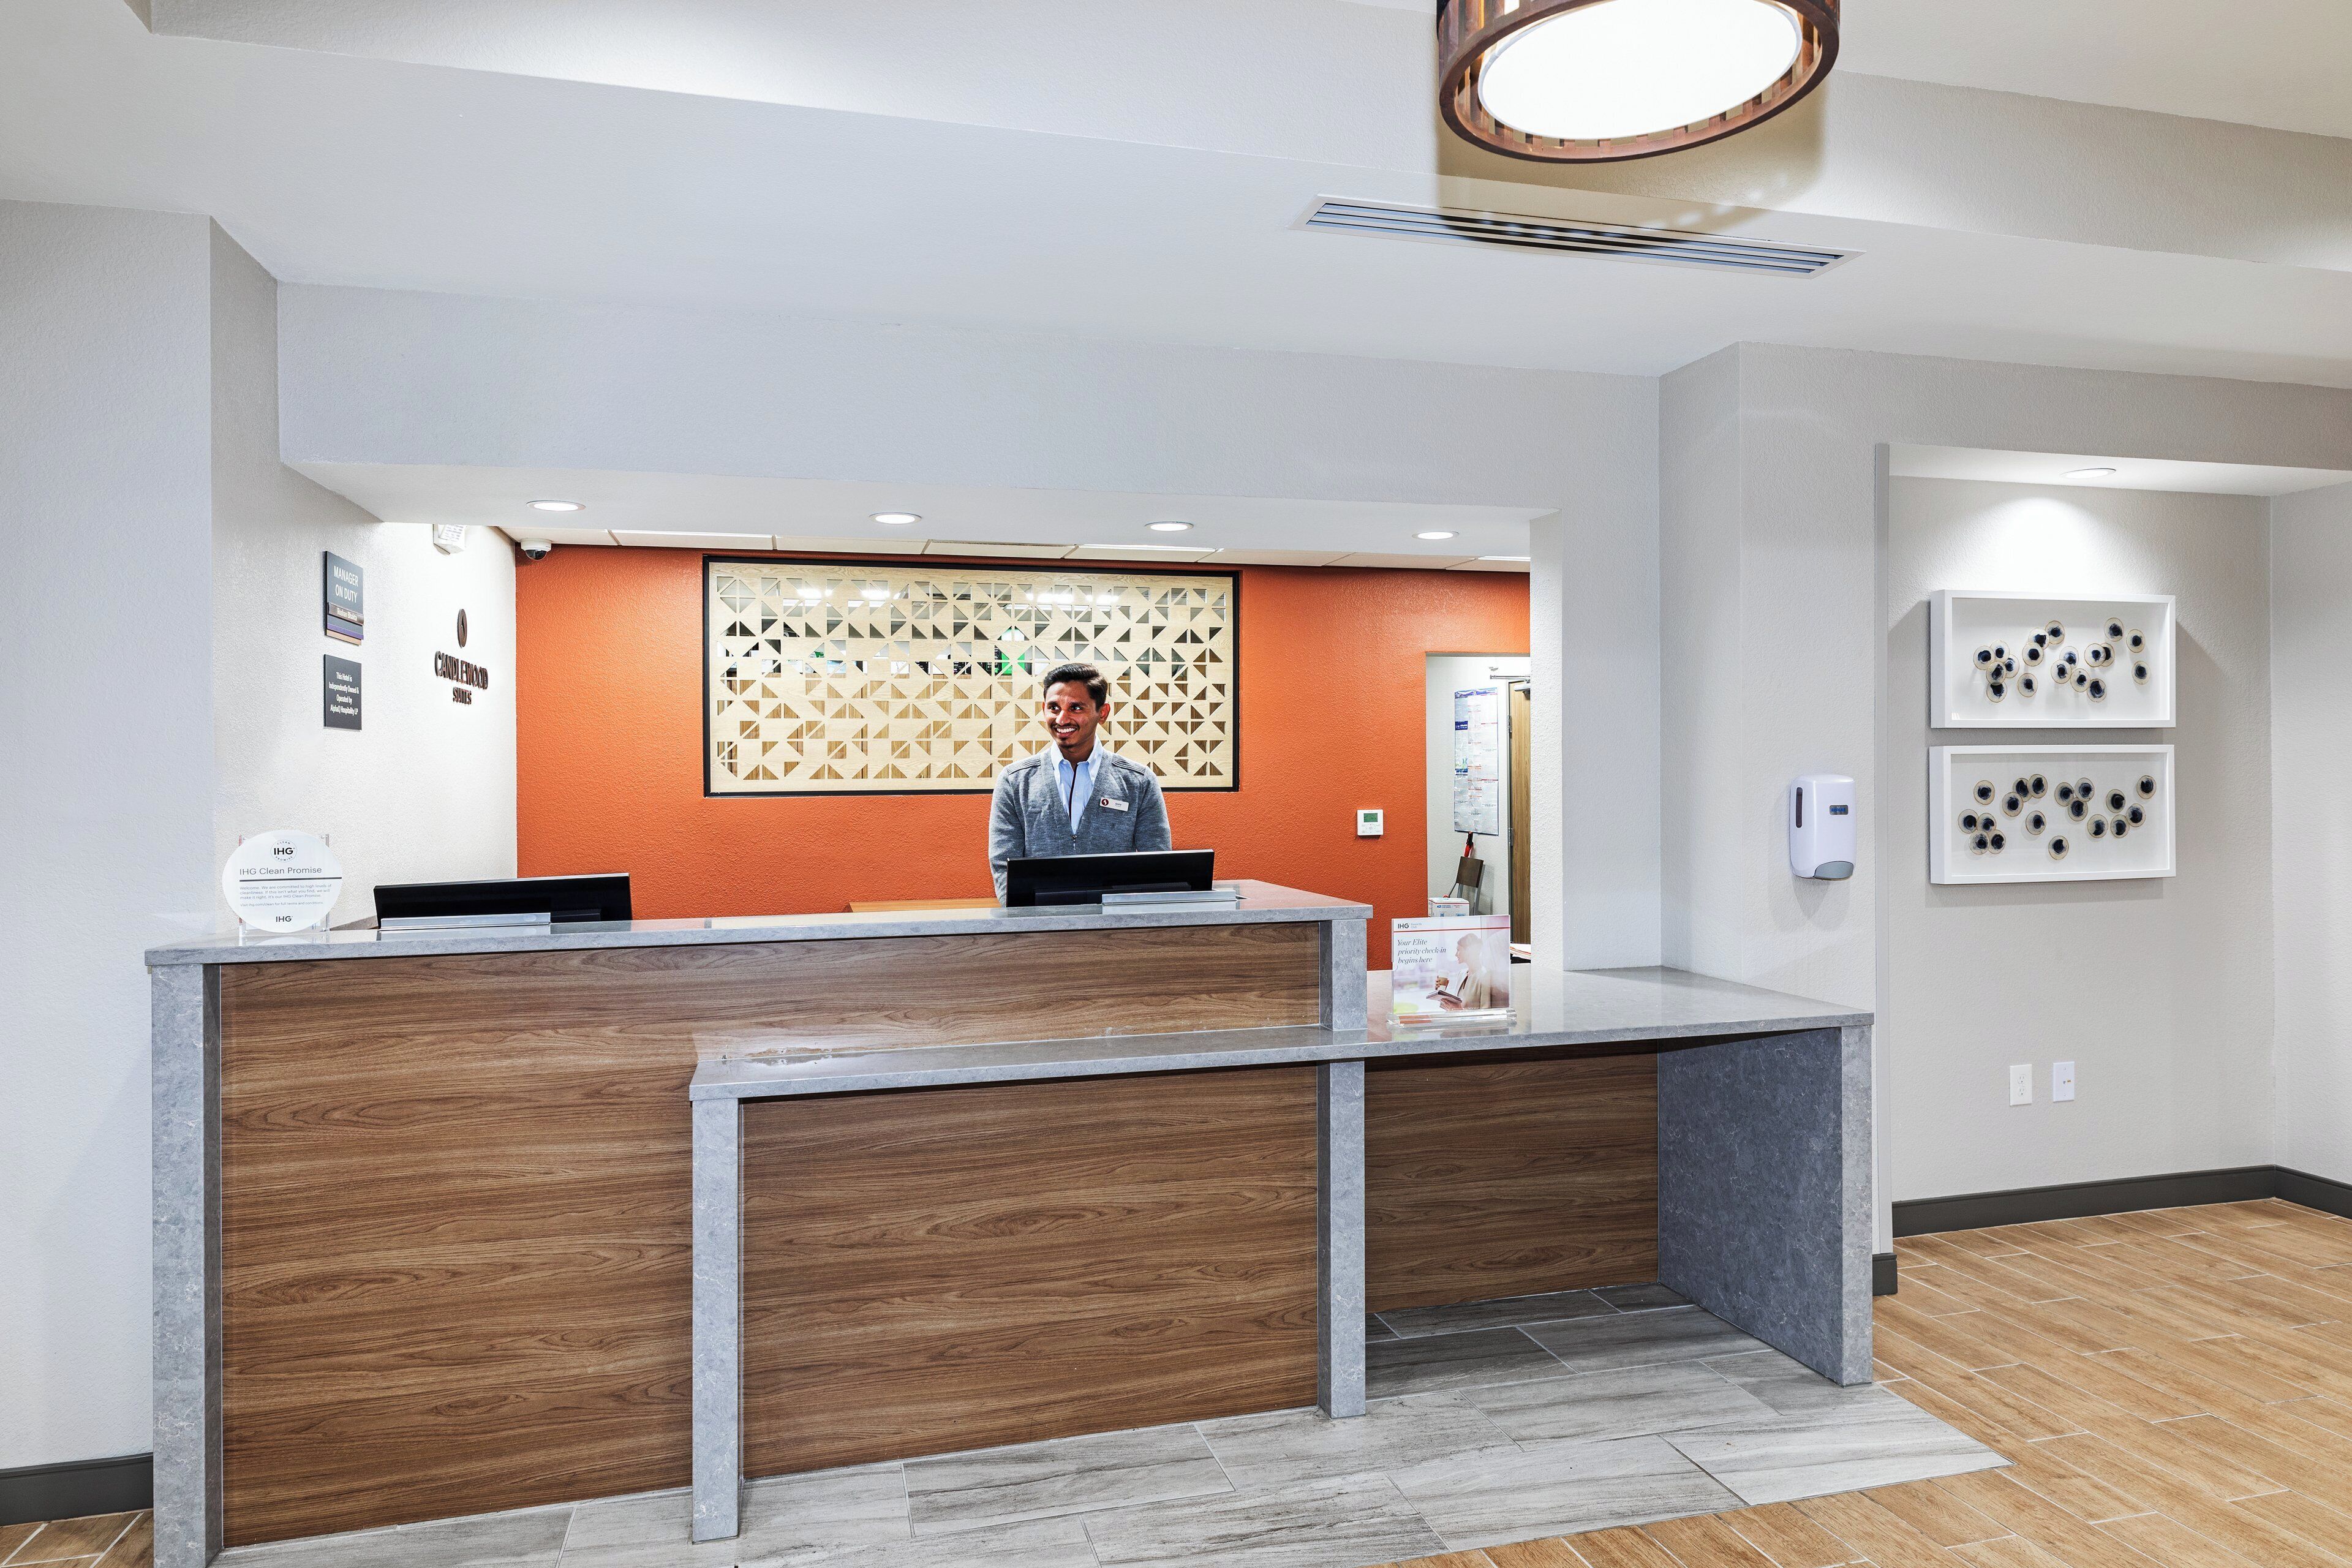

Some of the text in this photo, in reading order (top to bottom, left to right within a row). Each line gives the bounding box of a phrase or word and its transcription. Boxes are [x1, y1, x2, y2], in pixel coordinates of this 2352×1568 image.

[334, 566, 358, 587] MANAGER
[335, 584, 357, 603] ON DUTY
[434, 650, 489, 690] CANDLEWOOD
[329, 681, 347, 693] Independently
[347, 685, 356, 694] Owned
[453, 686, 472, 705] SUITES
[336, 694, 352, 705] Operated by
[341, 706, 354, 716] Hospitality
